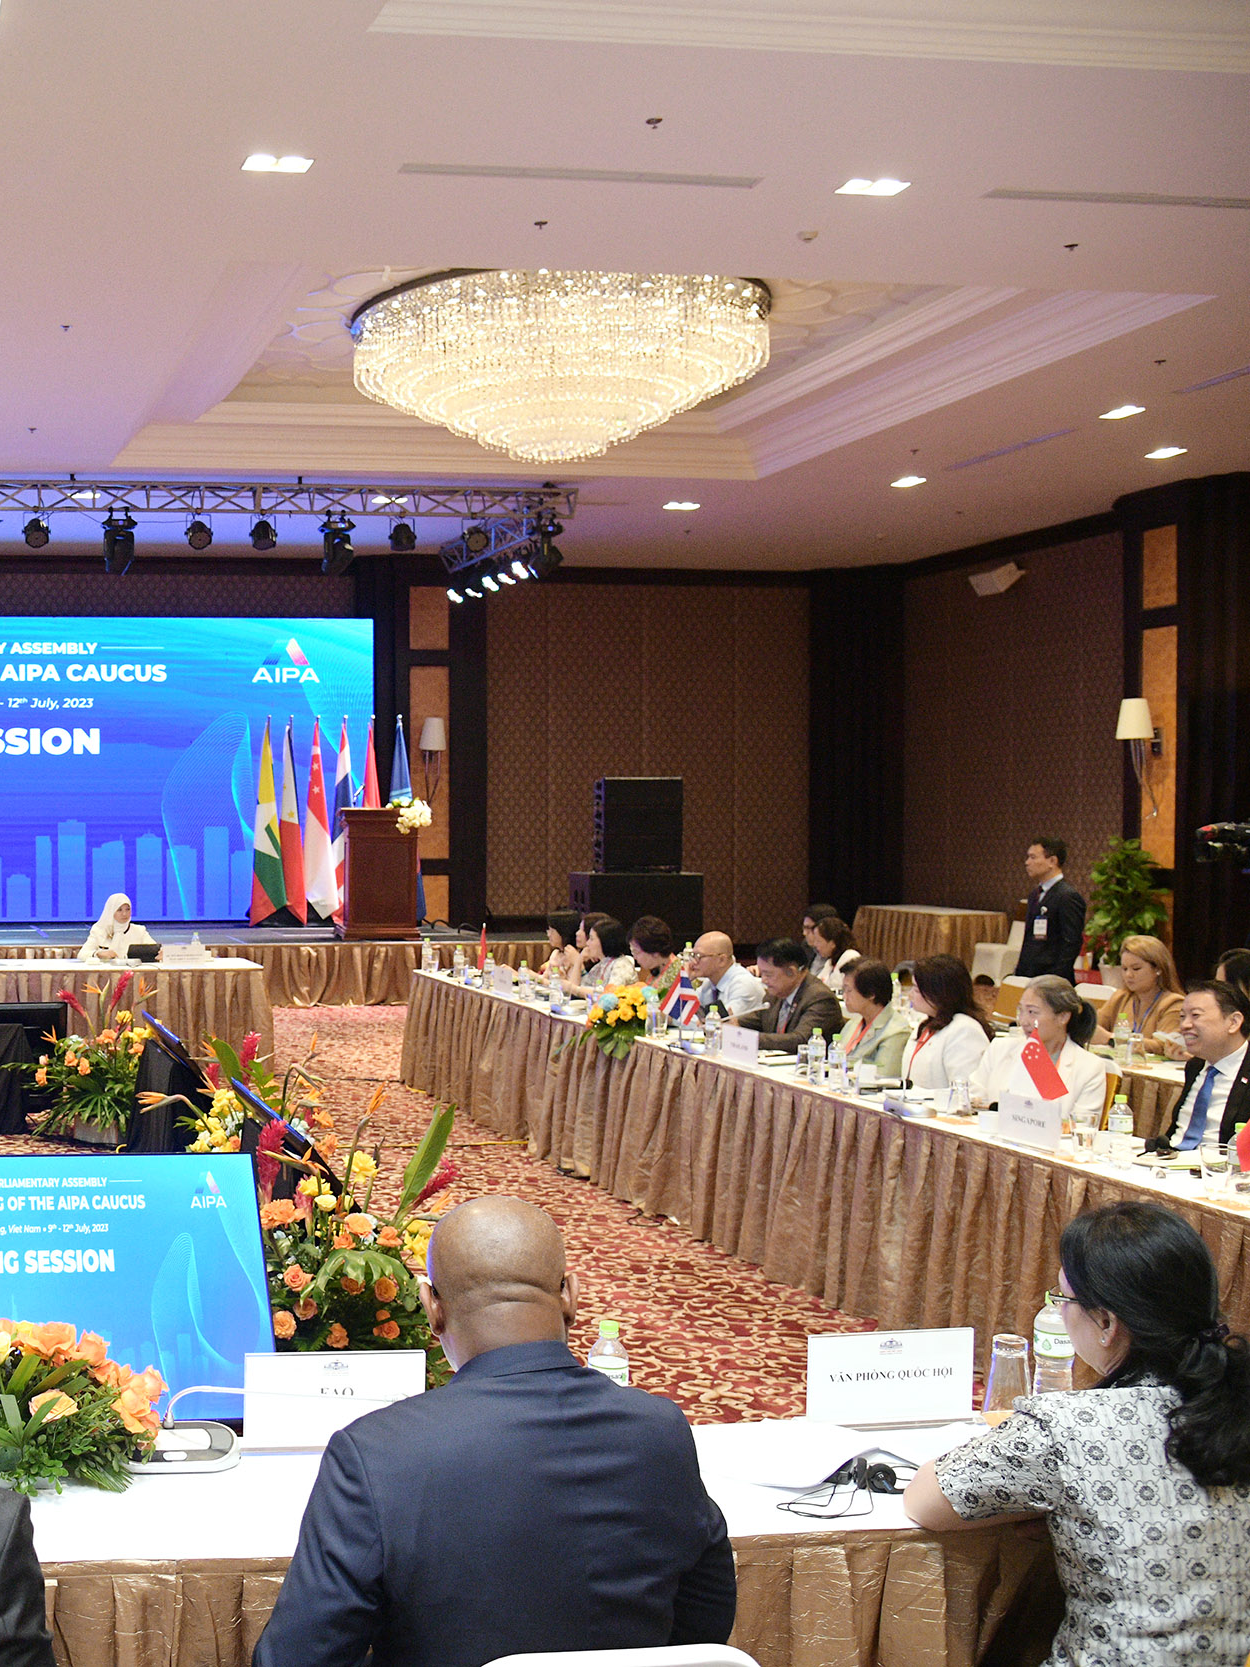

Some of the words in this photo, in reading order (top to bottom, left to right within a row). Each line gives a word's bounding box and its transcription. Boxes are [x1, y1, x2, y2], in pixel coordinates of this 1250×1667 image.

[10, 642, 97, 655] ASSEMBLY
[0, 664, 60, 682] AIPA
[66, 664, 167, 682] CAUCUS
[252, 667, 320, 683] AIPA
[30, 698, 60, 711] July,
[62, 698, 94, 708] 2023
[62, 1177, 107, 1187] ASSEMBLY
[7, 1196, 26, 1211] OF
[28, 1196, 55, 1211] THE
[57, 1195, 90, 1211] AIPA
[91, 1194, 146, 1210] CAUCUS
[190, 1195, 227, 1208] AIPA
[8, 1224, 23, 1233] Viet
[23, 1224, 41, 1233] Nam
[74, 1223, 91, 1235] July,
[91, 1223, 109, 1233] 2023
[24, 1249, 115, 1274] SESSION
